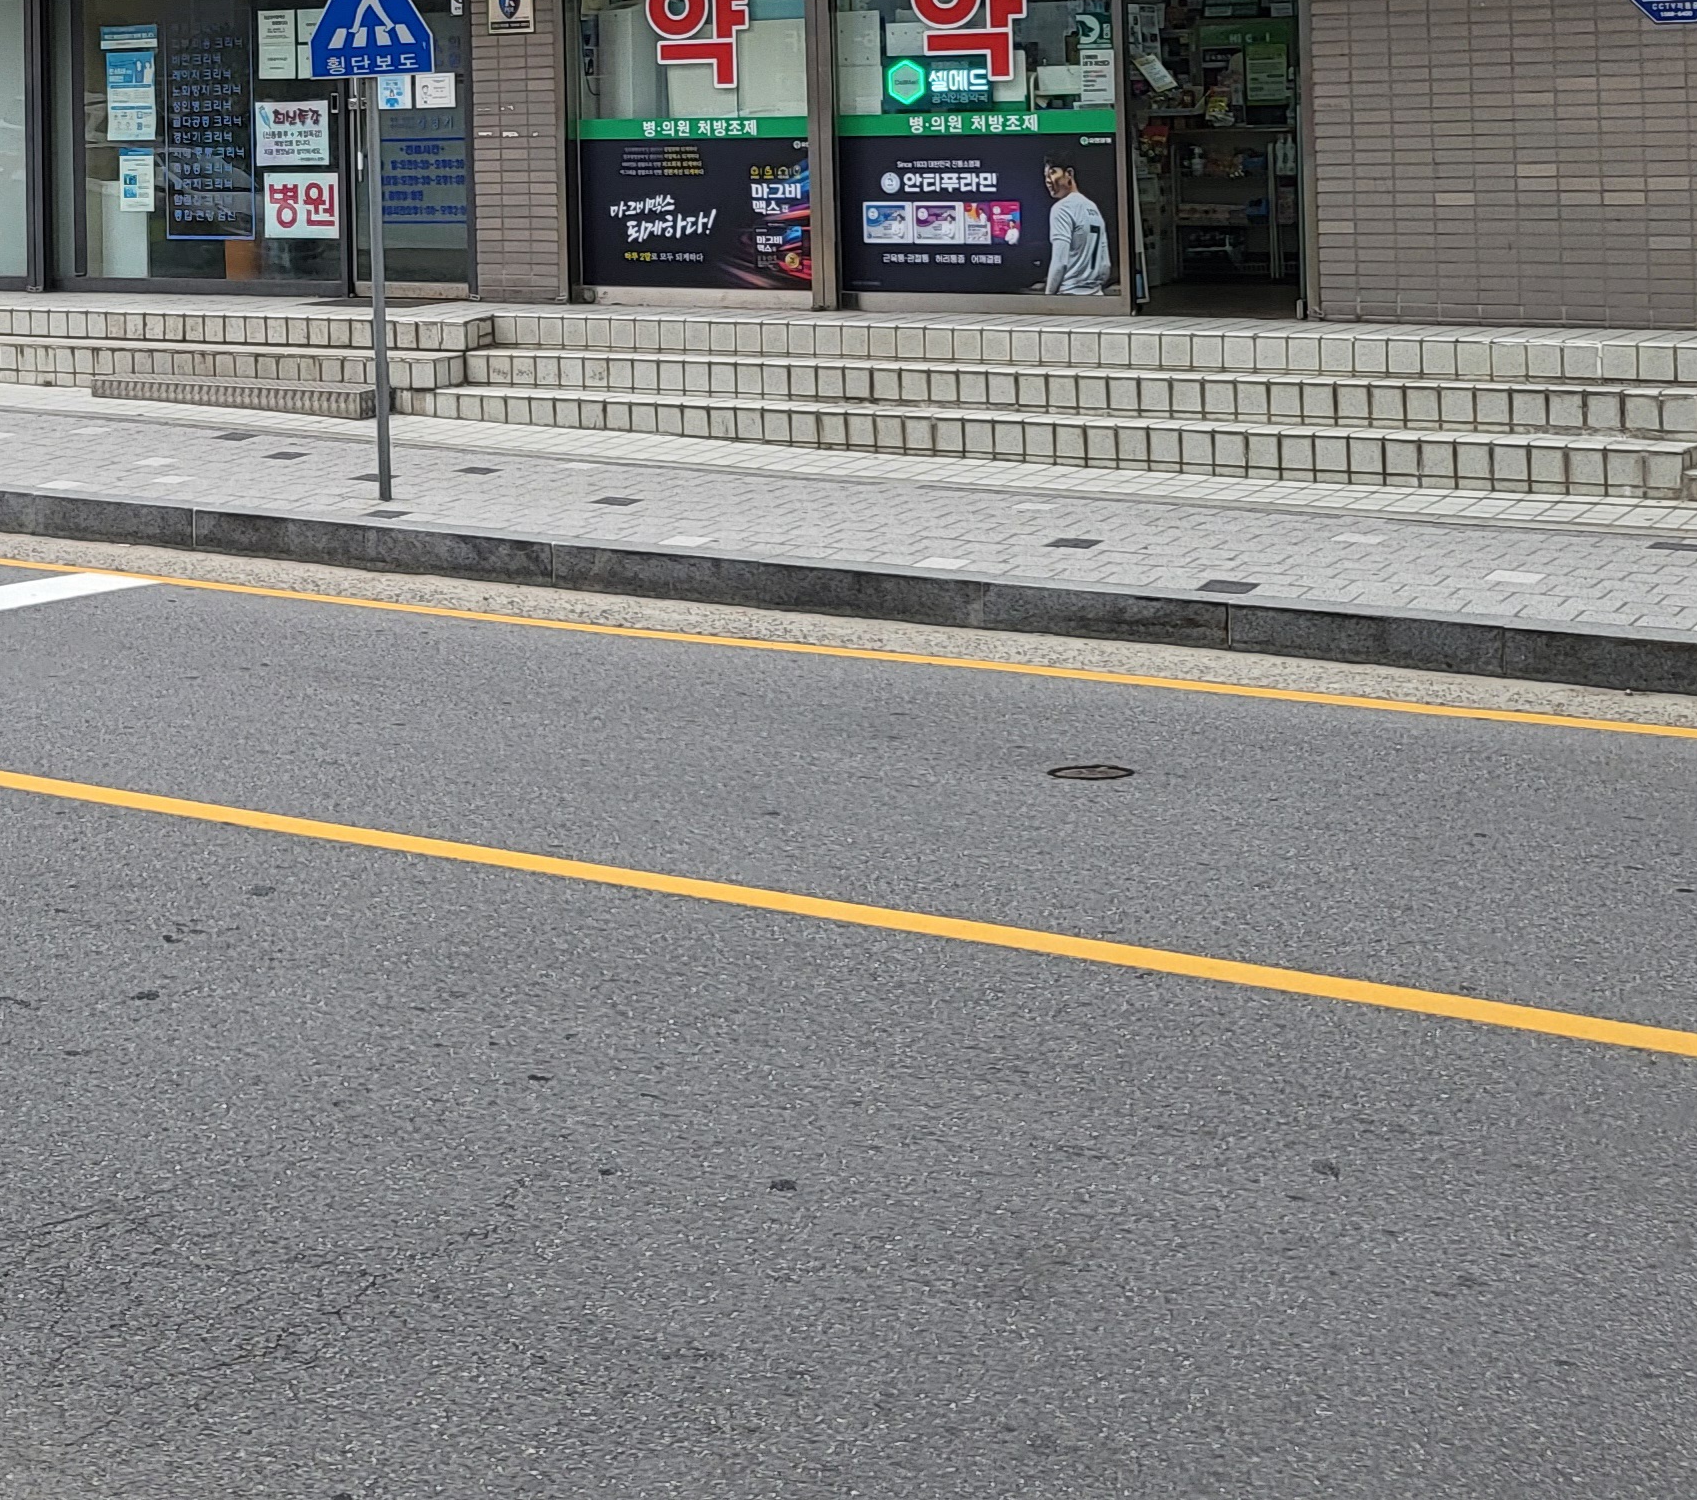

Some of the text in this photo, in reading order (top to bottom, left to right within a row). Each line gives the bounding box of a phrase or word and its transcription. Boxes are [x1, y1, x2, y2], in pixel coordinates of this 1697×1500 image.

[326, 53, 420, 75] 횡단보도
[931, 92, 988, 103] 공식인증약국
[642, 119, 758, 137] 병·의원 처방조제
[909, 113, 1039, 134] 병·의원 처방조제
[750, 183, 802, 199] 마그비
[903, 172, 998, 192] 안티푸라민
[268, 182, 336, 230] 병원
[609, 194, 676, 219] 마그비맥스
[752, 200, 781, 215] 맥스
[756, 235, 783, 245] 마그비
[1089, 224, 1101, 270] 7
[624, 252, 639, 262] 하루
[659, 253, 673, 262] 모두
[934, 254, 966, 264] 허리통증
